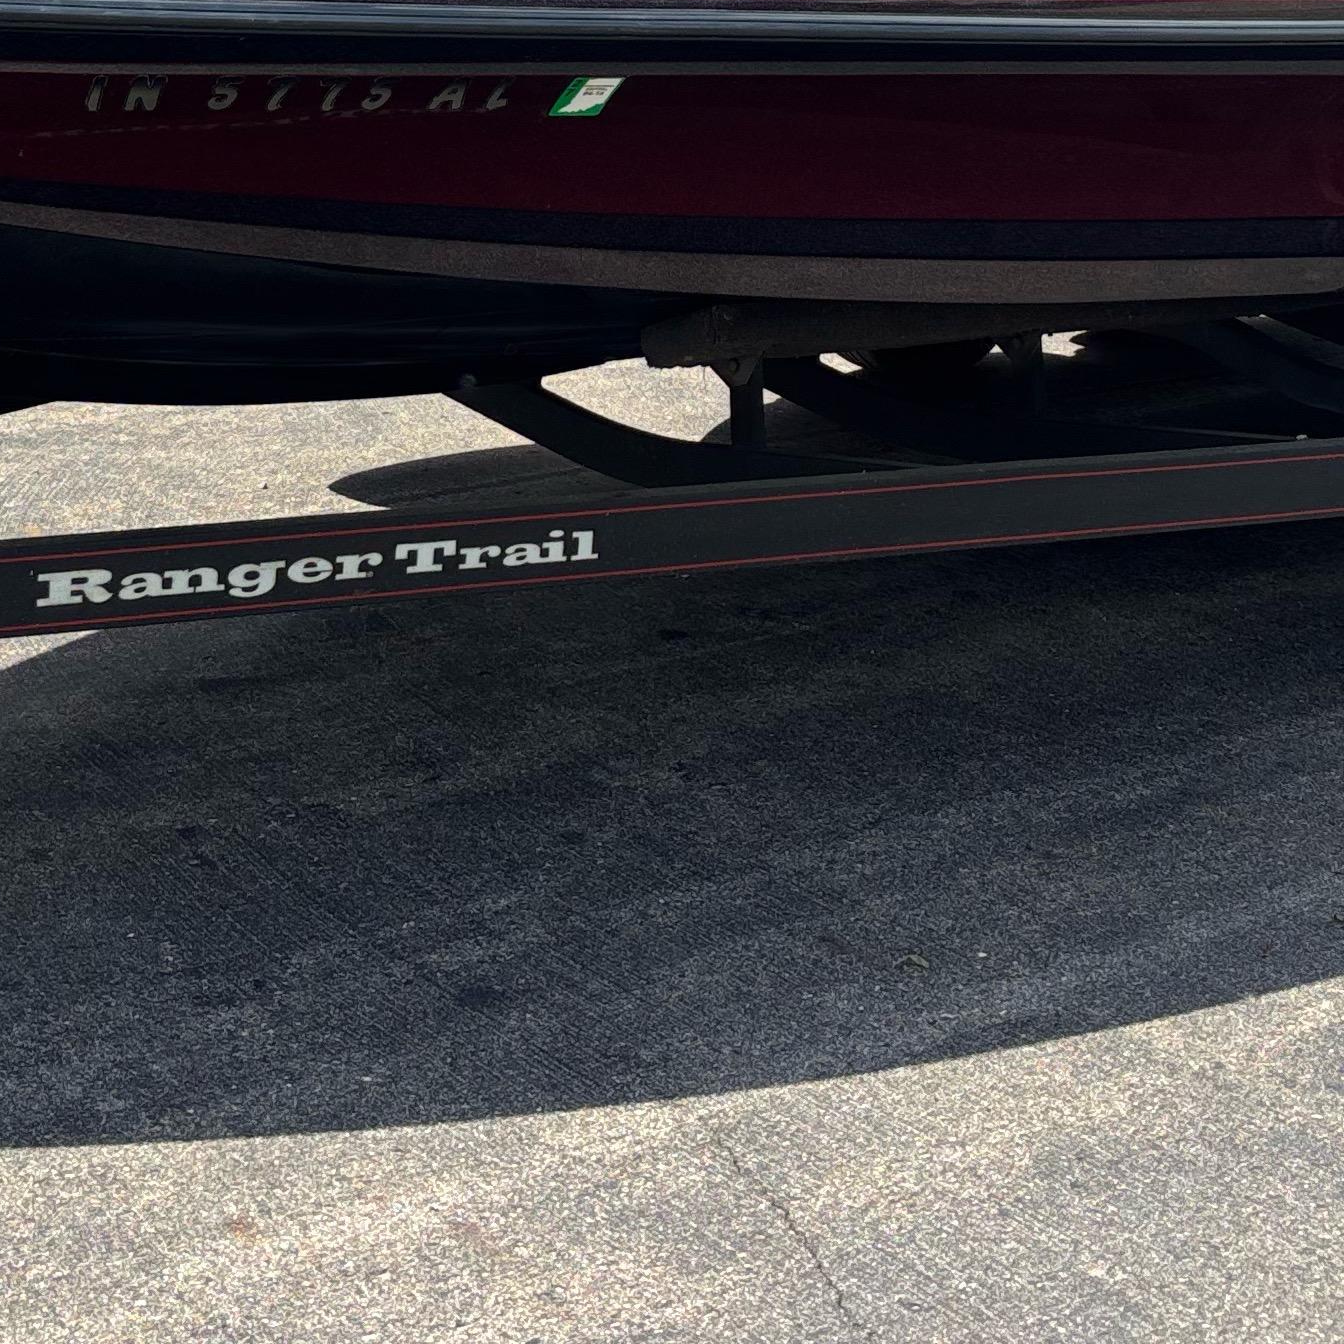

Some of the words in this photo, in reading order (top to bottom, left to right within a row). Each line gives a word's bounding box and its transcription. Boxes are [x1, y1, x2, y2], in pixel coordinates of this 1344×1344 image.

[85, 74, 168, 112] IN
[36, 551, 382, 607] Ranger
[395, 529, 599, 576] Trail
